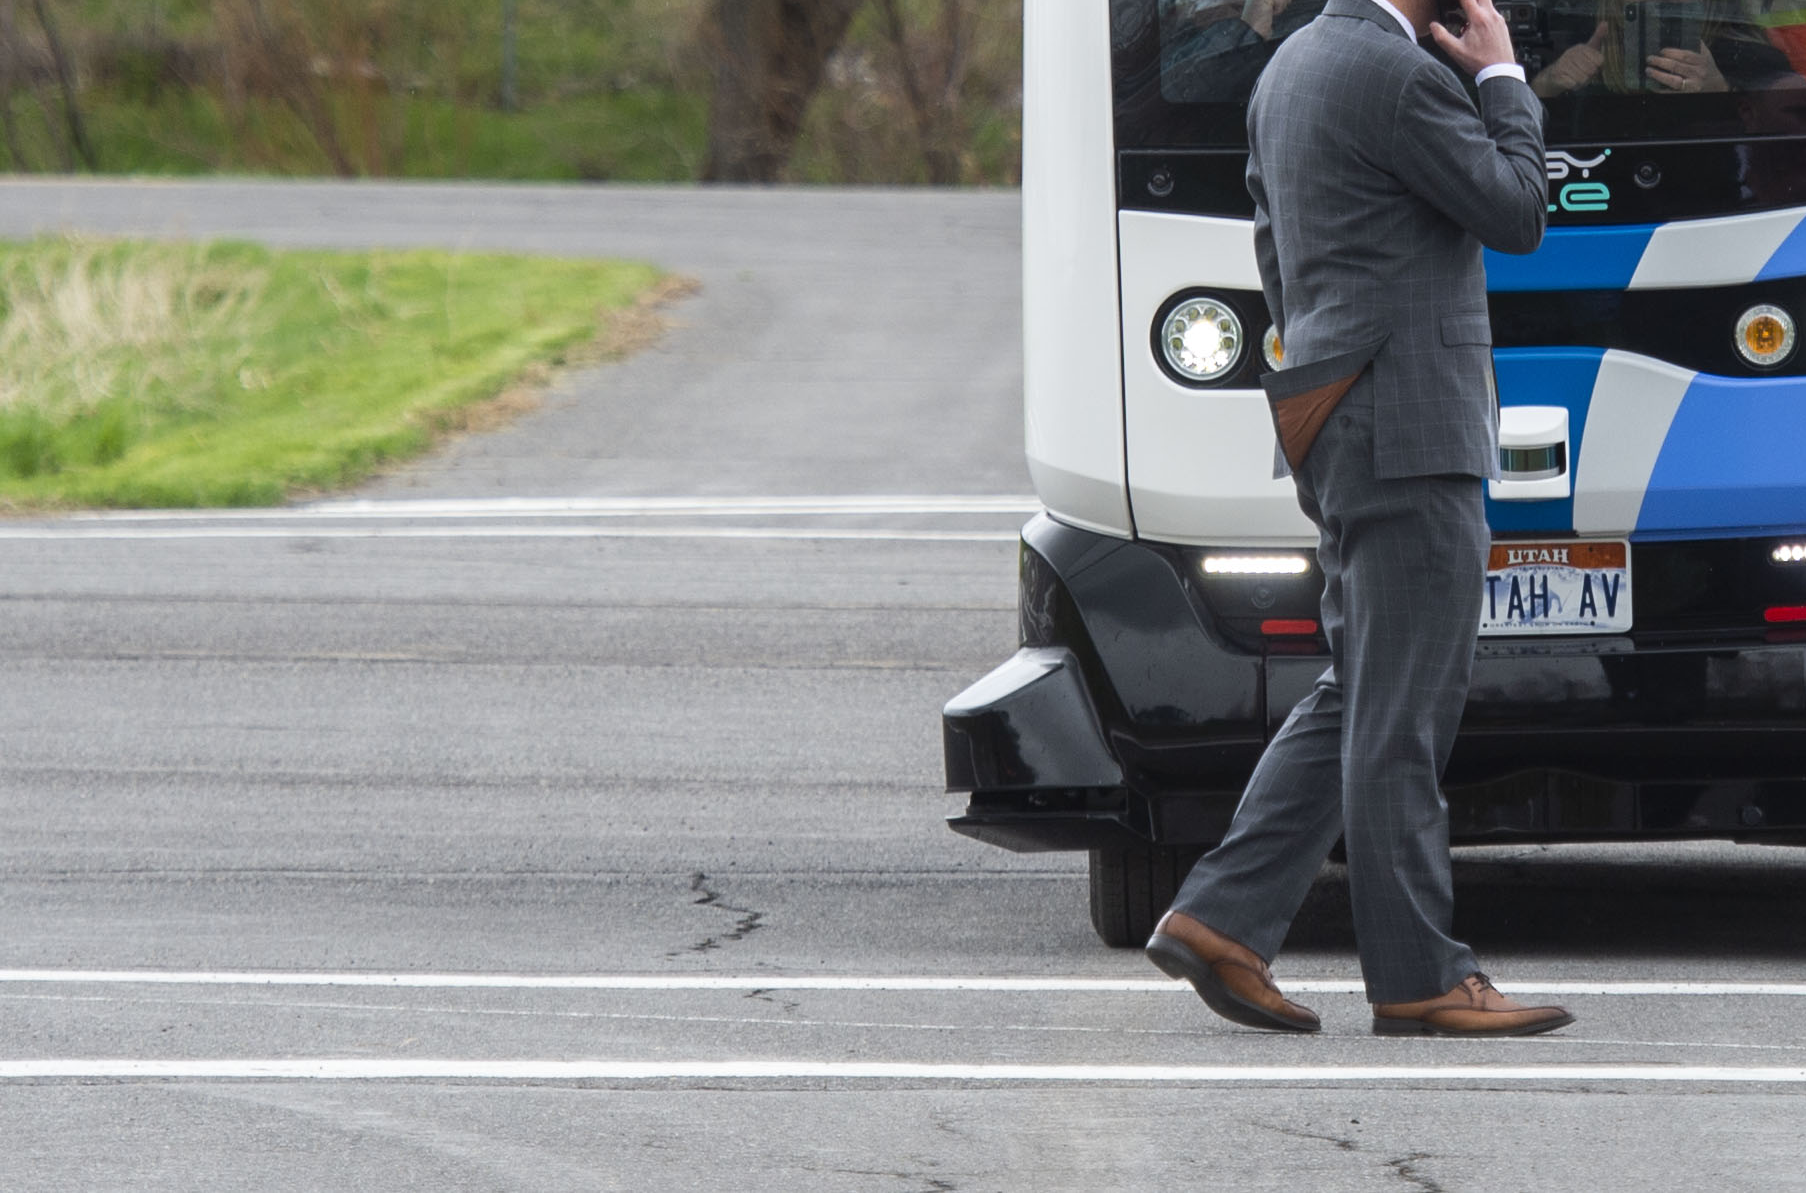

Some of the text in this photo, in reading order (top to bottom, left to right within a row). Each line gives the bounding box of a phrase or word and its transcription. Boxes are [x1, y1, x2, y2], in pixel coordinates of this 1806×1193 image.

[1507, 548, 1569, 565] UTAH
[1486, 572, 1621, 620] TAH AV
